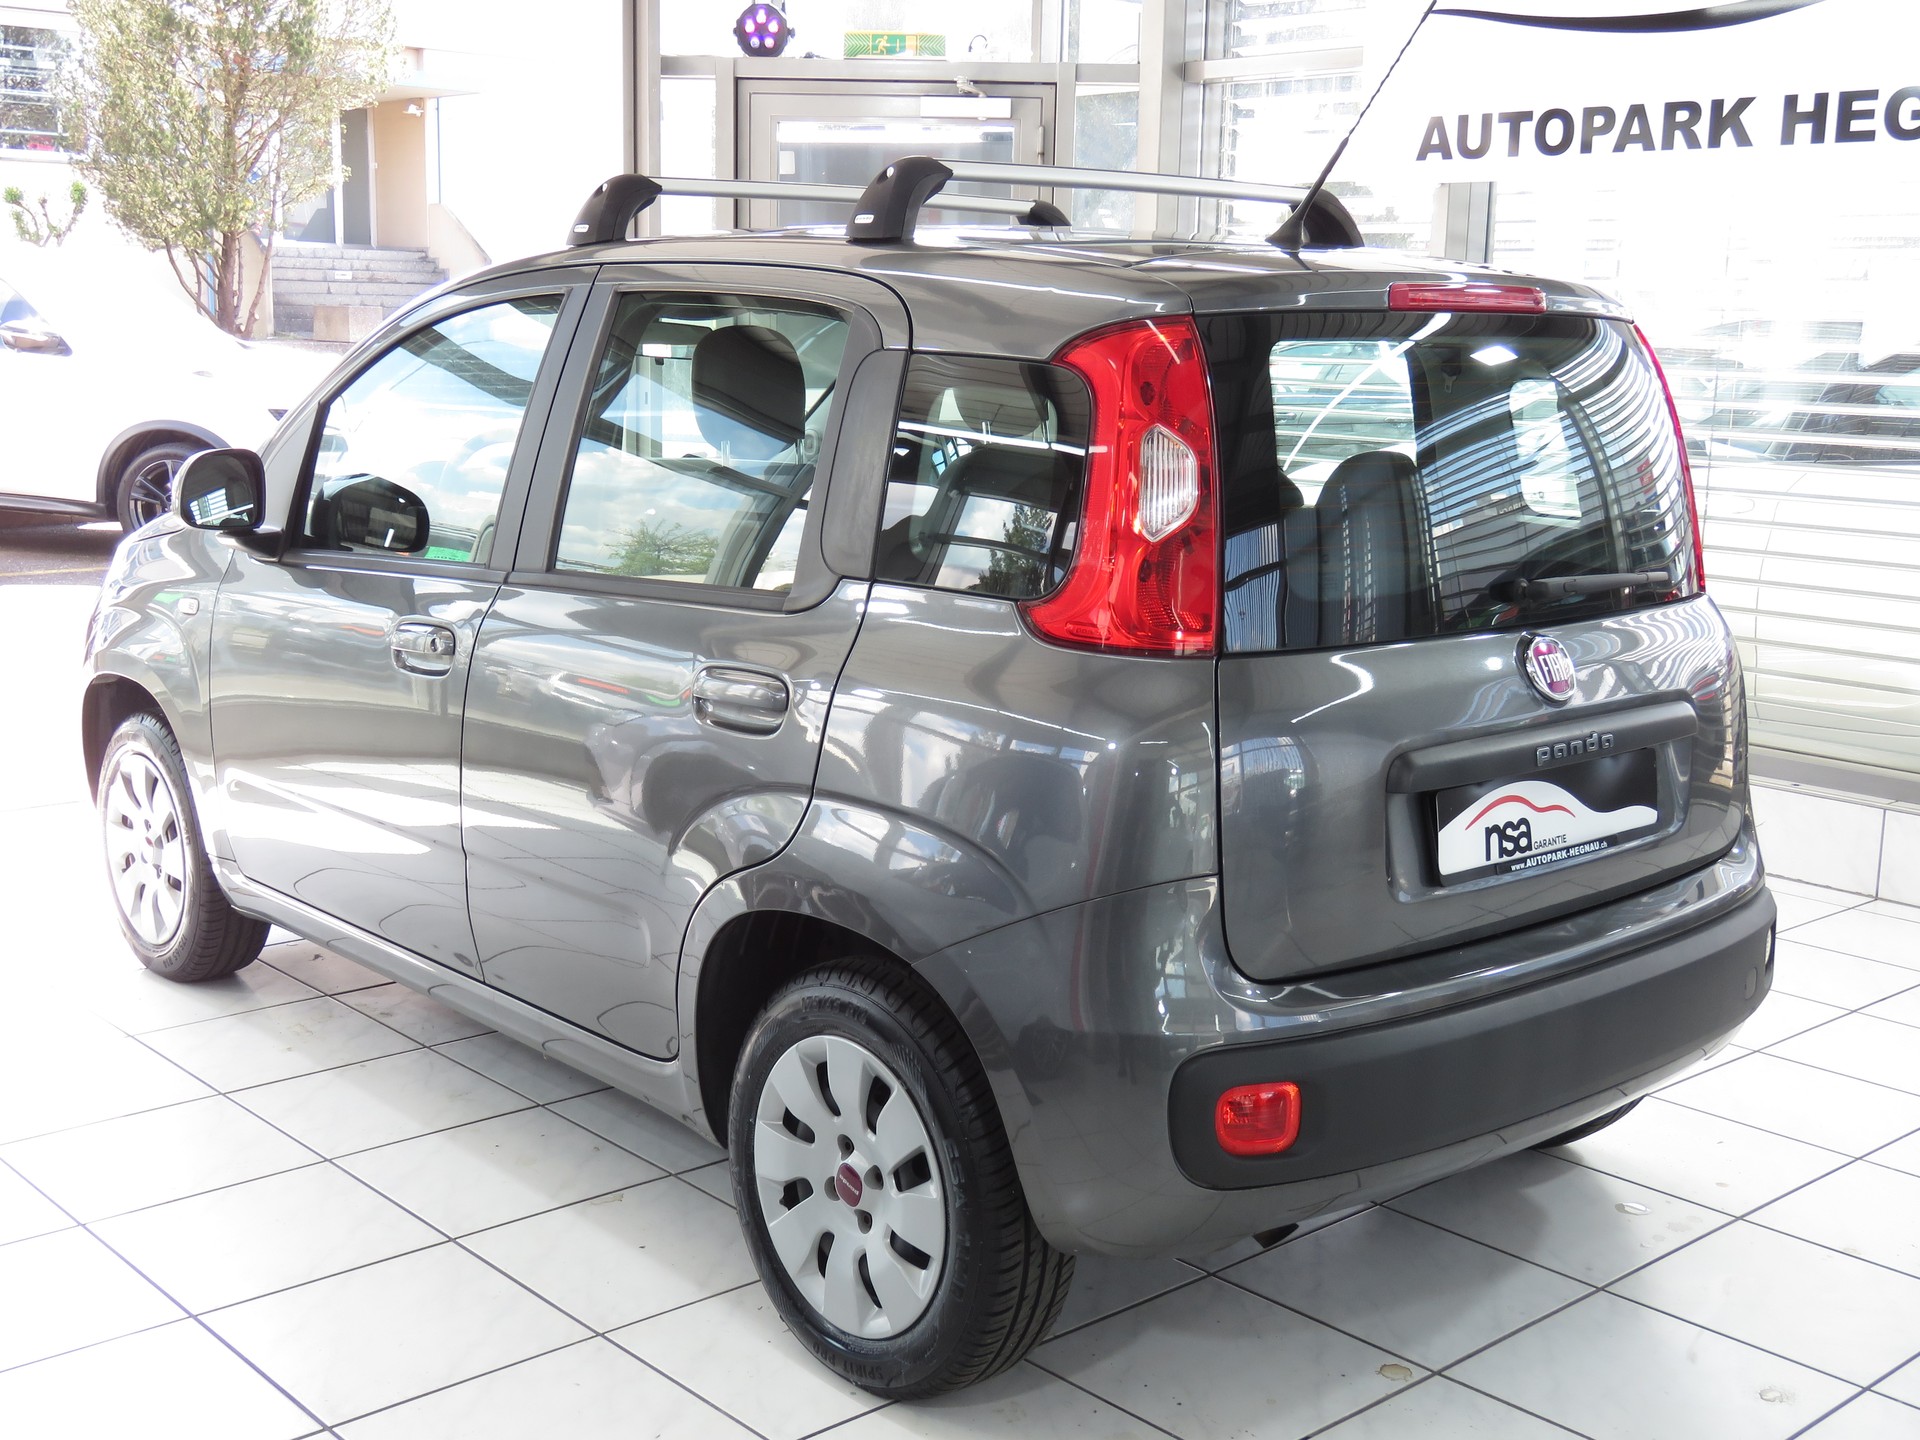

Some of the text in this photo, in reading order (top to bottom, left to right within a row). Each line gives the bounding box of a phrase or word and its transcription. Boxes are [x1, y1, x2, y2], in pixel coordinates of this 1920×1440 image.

[1416, 86, 1920, 161] AUTOPARK HEG
[1538, 653, 1569, 683] FIAT
[1536, 731, 1615, 766] panda
[1485, 817, 1567, 861] nsa GARANTIE
[1511, 841, 1607, 871] www.AUTOPARK-HEGNAU.ch
[843, 1360, 884, 1380] SPIRIT
